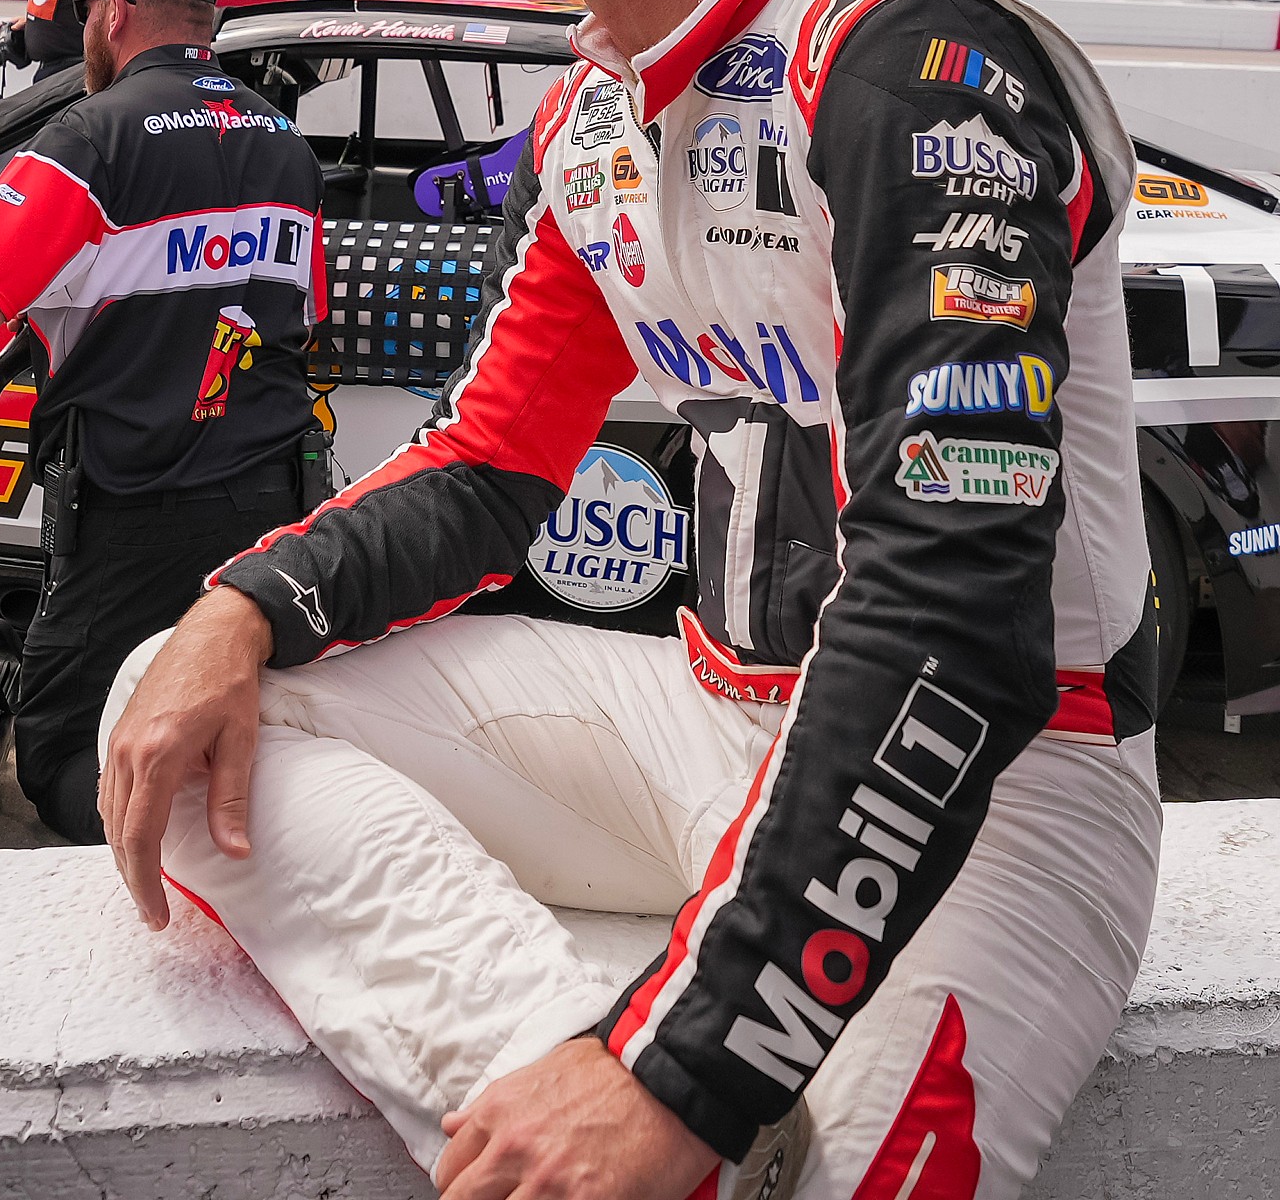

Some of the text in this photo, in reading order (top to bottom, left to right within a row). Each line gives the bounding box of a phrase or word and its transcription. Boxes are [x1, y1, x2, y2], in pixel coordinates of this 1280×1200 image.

[300, 19, 365, 39] Kevin
[983, 57, 1025, 113] 75
[913, 134, 1037, 199] BUSCH
[945, 177, 1018, 207] LIGHT
[1136, 208, 1228, 220] GEARWRENCH
[912, 212, 1030, 262] HAAS
[953, 298, 1020, 316] TRUCK CENTERS
[905, 353, 1055, 418] SUNNYD
[941, 444, 1052, 472] campers
[961, 469, 1046, 499] inn RV
[537, 497, 689, 567] USCH
[543, 549, 650, 585] LIGHT
[556, 579, 634, 595] BREWED IN U.S.A.
[723, 784, 936, 1093] Mobil
